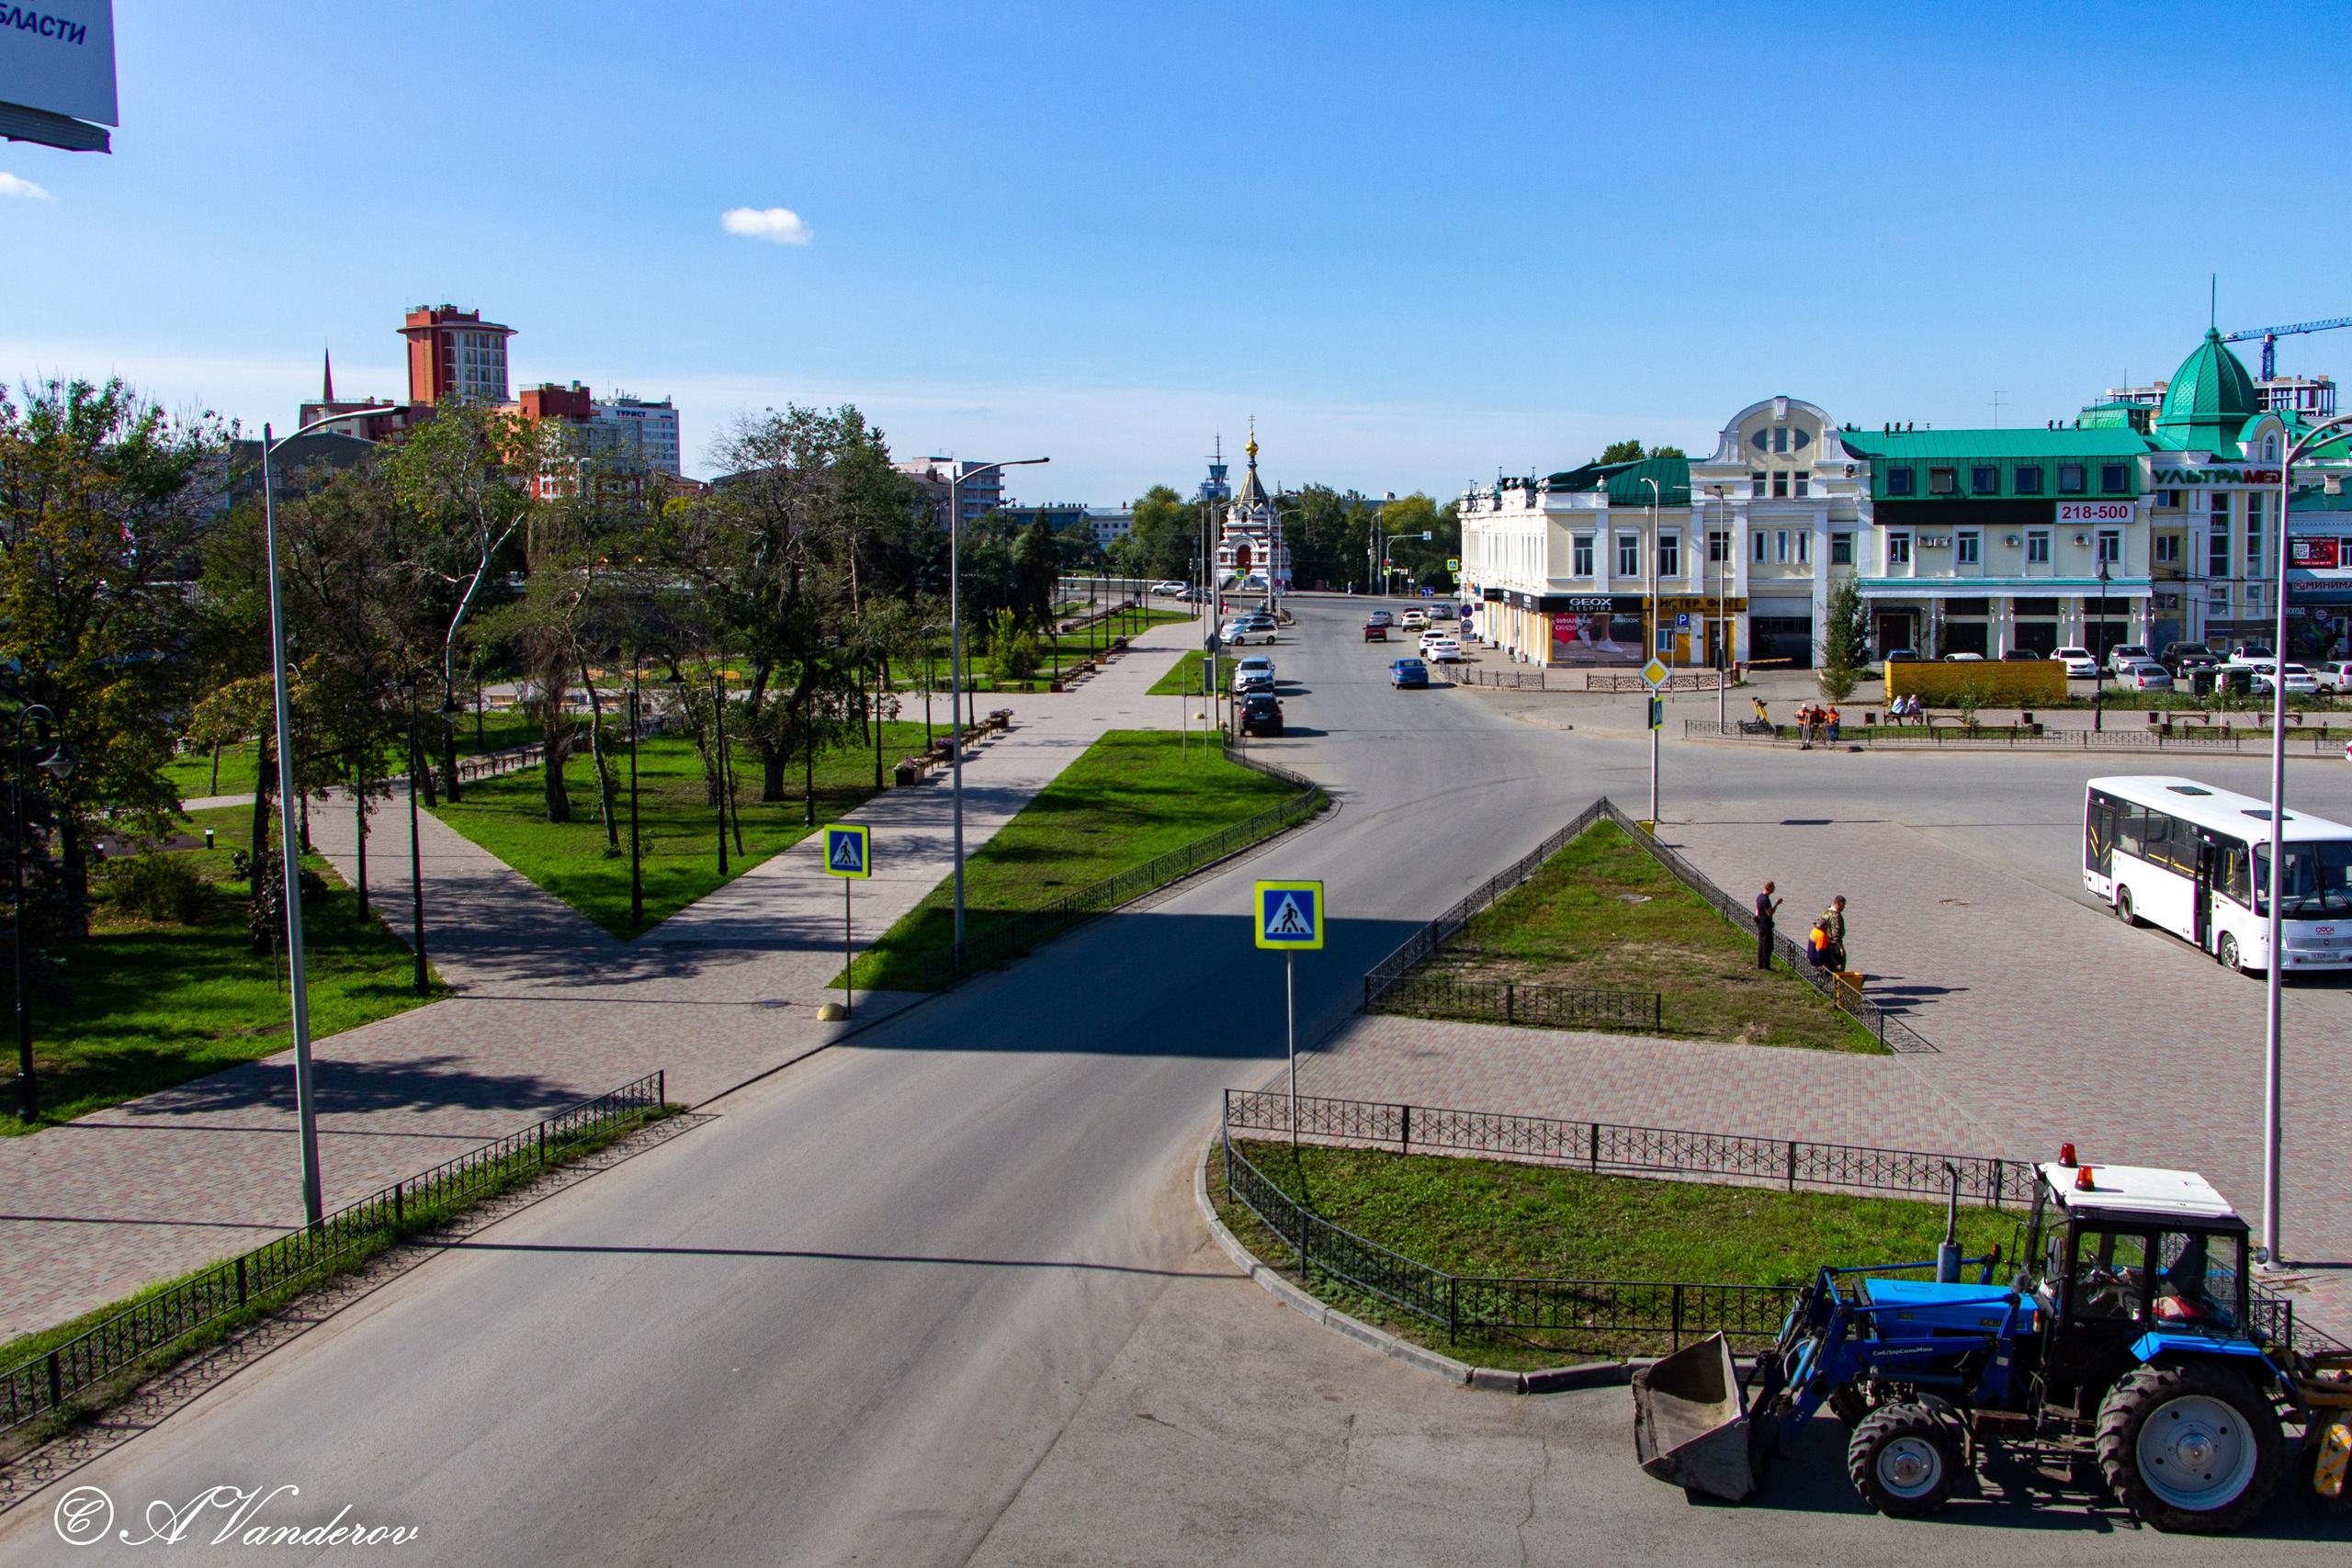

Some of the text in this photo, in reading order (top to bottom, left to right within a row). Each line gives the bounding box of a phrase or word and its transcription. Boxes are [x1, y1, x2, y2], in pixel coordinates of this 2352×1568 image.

[616, 410, 647, 418] ТУРИСТ
[2062, 505, 2128, 519] 218-500
[2286, 607, 2305, 615] ВХОД
[1679, 615, 1687, 625] P
[1872, 1347, 1933, 1356] СибДорСельМаш
